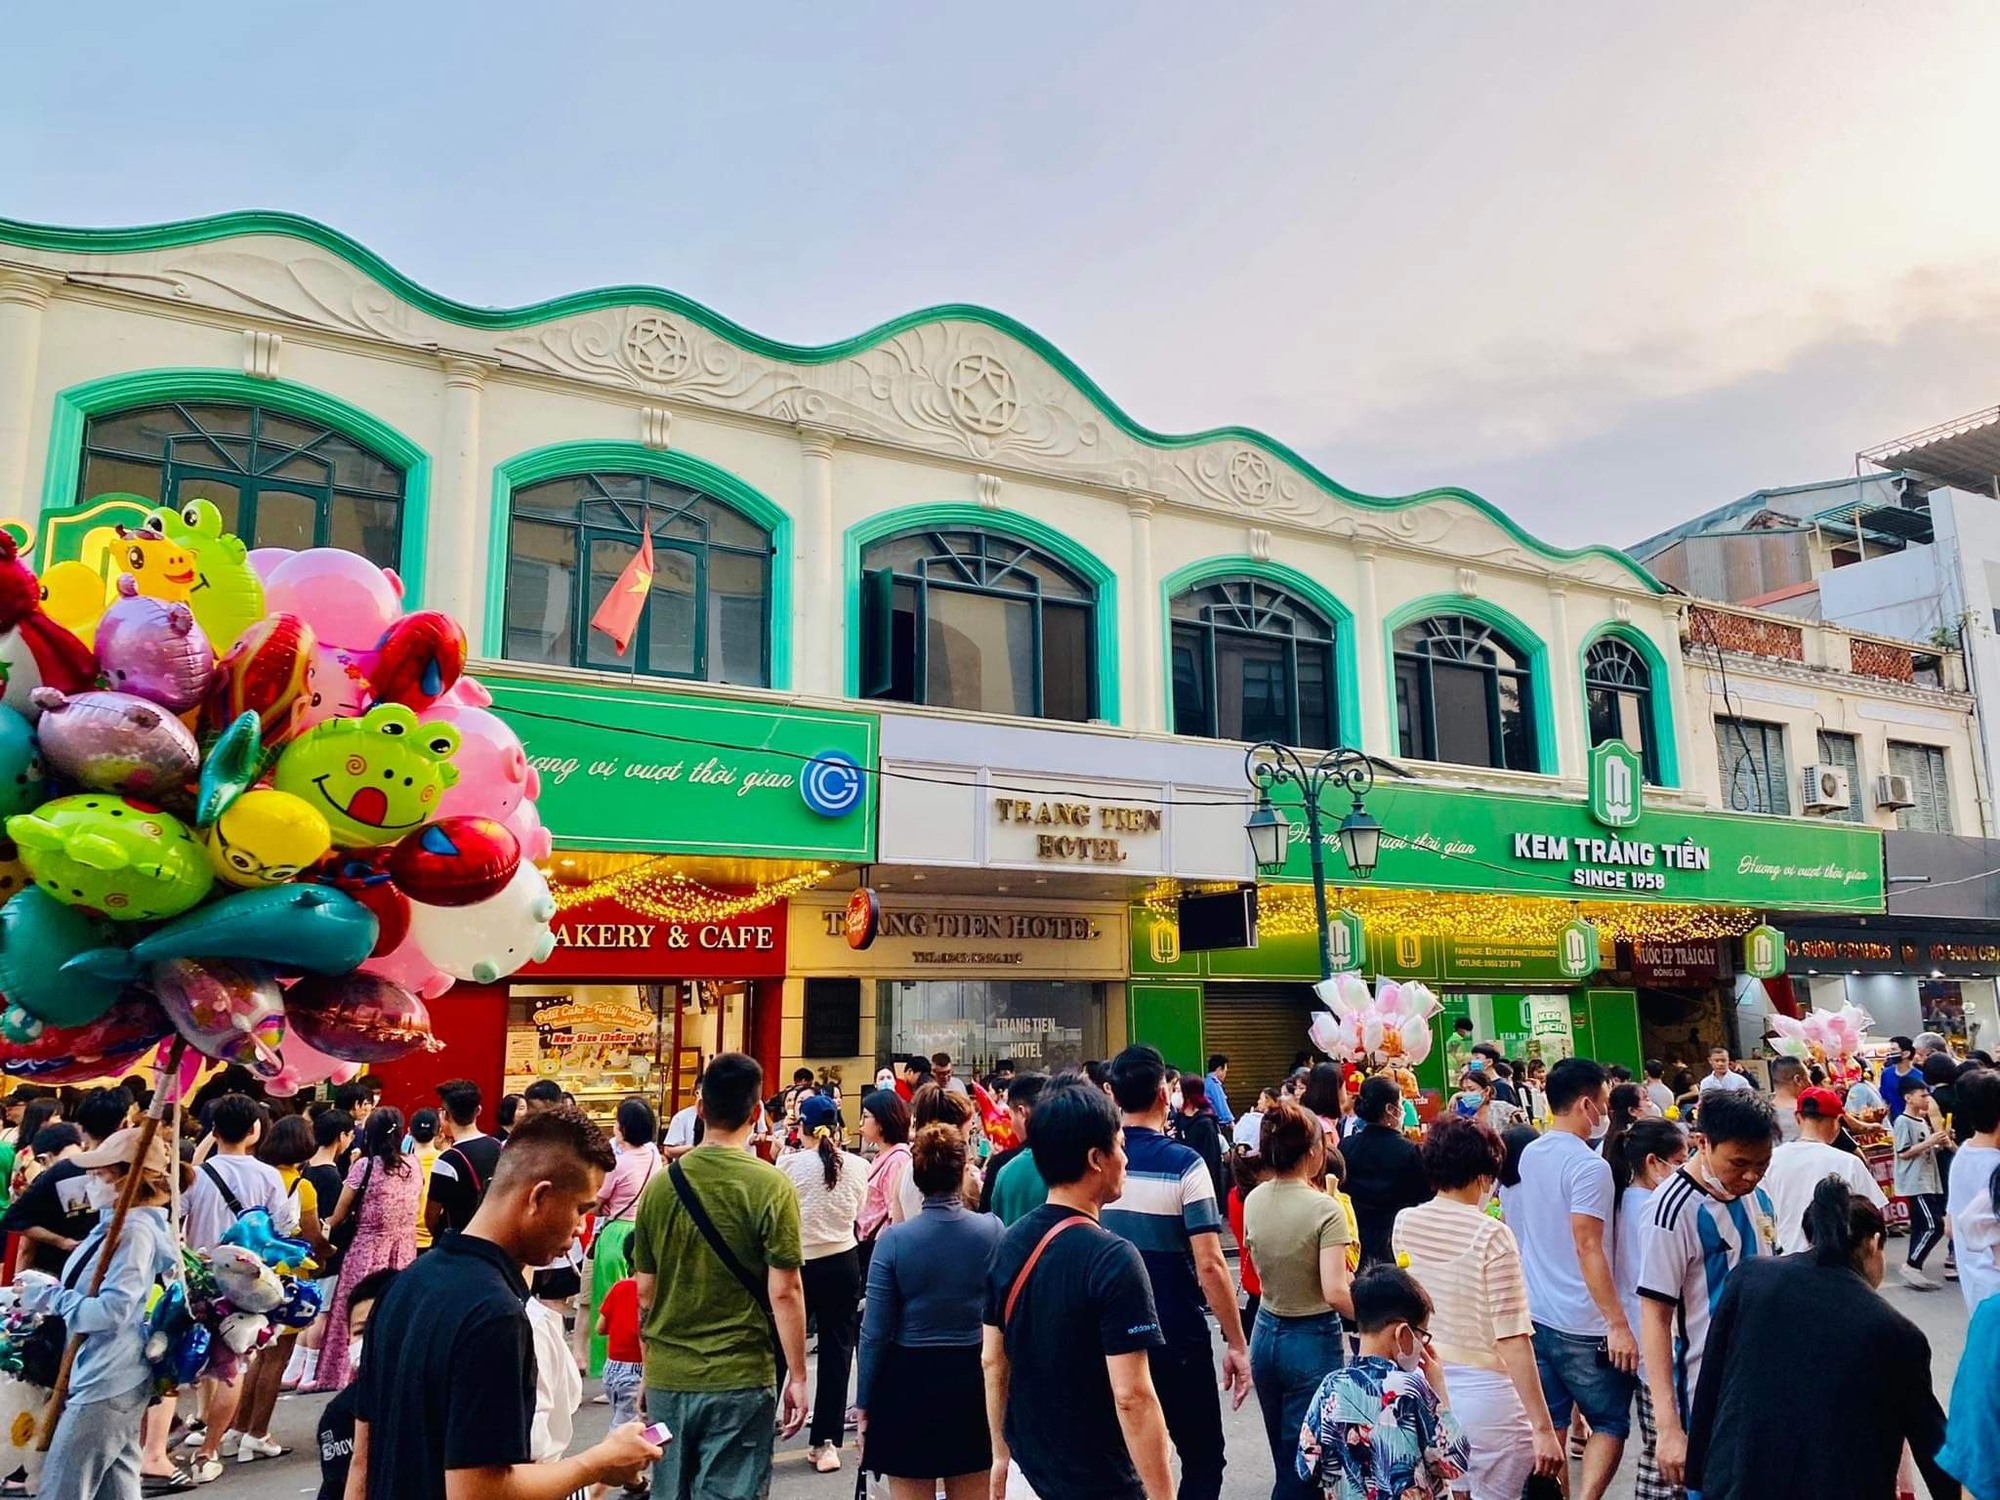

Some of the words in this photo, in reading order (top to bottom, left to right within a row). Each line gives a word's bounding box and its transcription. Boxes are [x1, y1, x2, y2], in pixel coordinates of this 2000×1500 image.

[587, 757, 619, 781] vị
[624, 760, 684, 785] vượt
[688, 757, 737, 786] thời
[736, 769, 795, 797] gian
[995, 797, 1092, 828] TRANG
[1099, 805, 1163, 833] TIEN
[1036, 834, 1127, 862] HOTEL
[1440, 841, 1477, 860] gian
[1514, 832, 1569, 861] KEM
[1573, 832, 1656, 866] TRÀNG
[1660, 835, 1711, 870] TIỀN
[1573, 868, 1627, 888] SINCE
[1631, 871, 1666, 890] 1958
[554, 923, 656, 948] AKERY
[667, 925, 690, 949] &
[699, 926, 774, 949] CAFE
[937, 914, 1002, 939] TIEN
[1007, 915, 1101, 941] HOTEL
[620, 1007, 652, 1024] Happy
[995, 1018, 1032, 1034] TRANG
[1033, 1018, 1056, 1033] TIEN
[553, 1033, 575, 1043] New
[577, 1034, 598, 1043] Size
[1009, 1042, 1043, 1059] HOTEL
